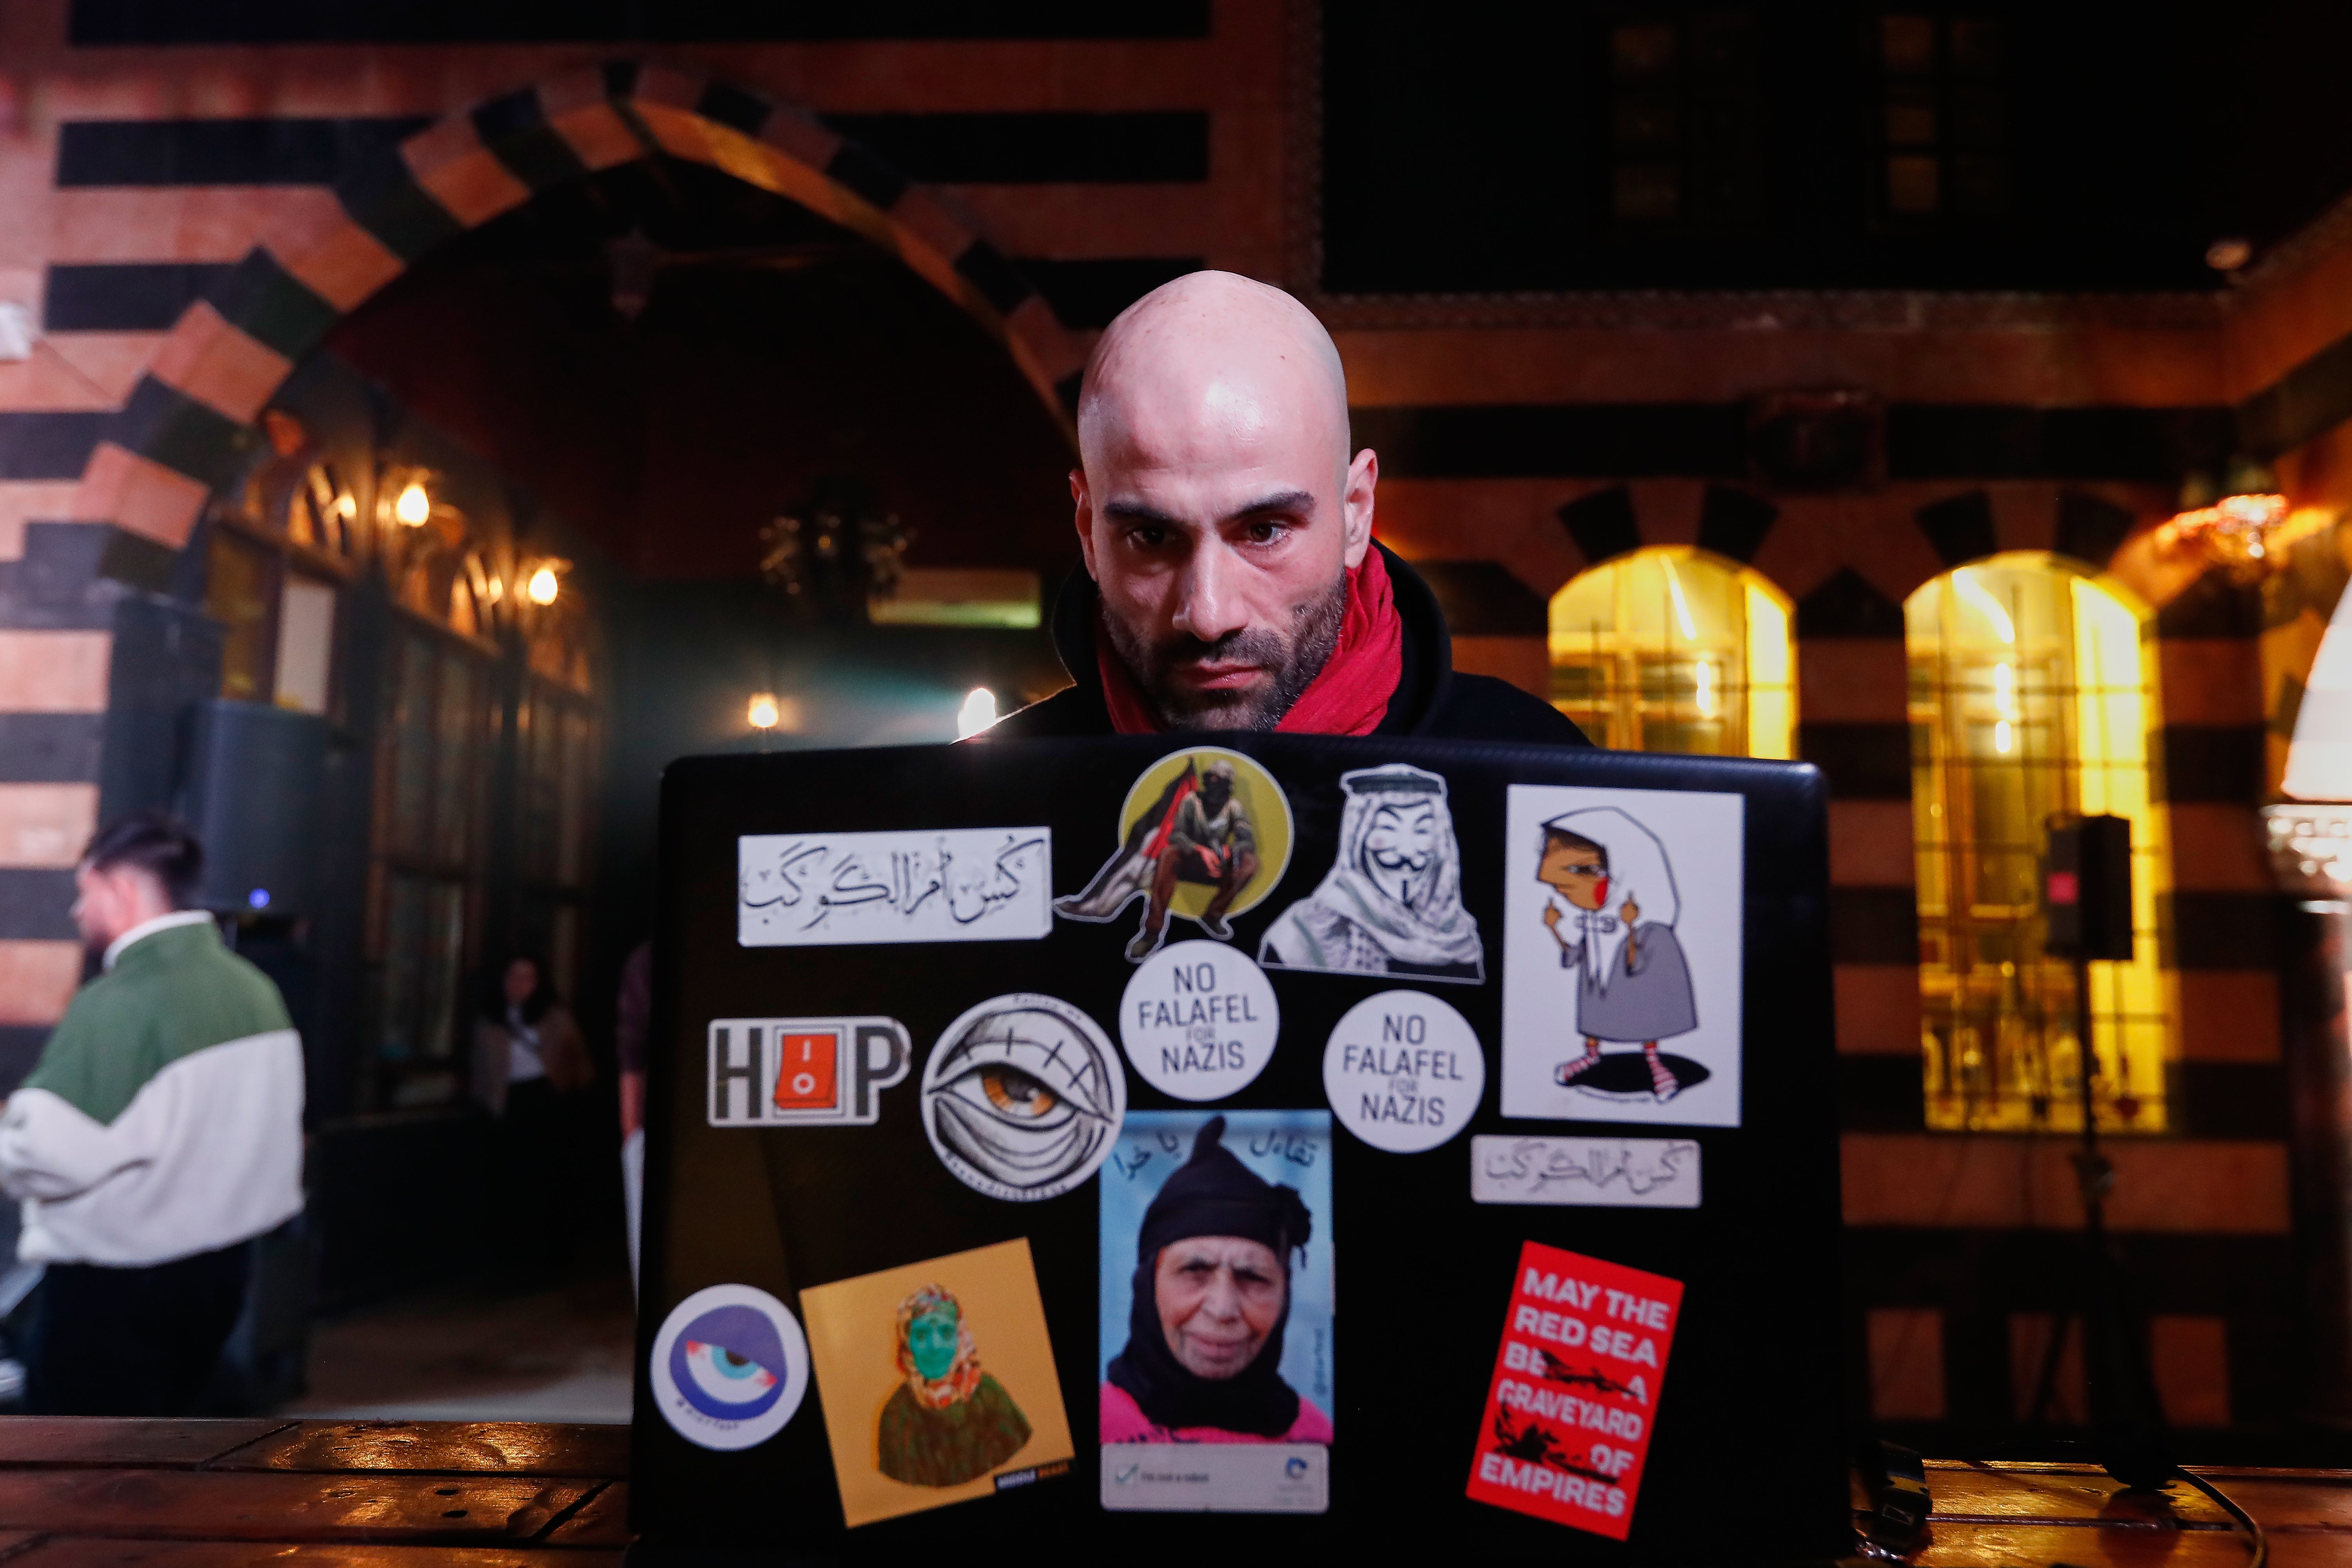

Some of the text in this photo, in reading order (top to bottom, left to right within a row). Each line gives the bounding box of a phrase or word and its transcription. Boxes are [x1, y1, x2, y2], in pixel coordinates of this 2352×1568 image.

[1173, 962, 1216, 993] NO
[1138, 993, 1259, 1029] FALAFEL
[1383, 1013, 1426, 1045] NO
[1161, 1040, 1245, 1074] NAZIS
[1343, 1044, 1464, 1081] FALAFEL
[1360, 1093, 1445, 1127] NAZIS
[1523, 1267, 1670, 1332] MAY THE
[1514, 1304, 1659, 1369] RED SEA
[1622, 1374, 1648, 1405] A
[1496, 1378, 1643, 1442] GRAVEYARD
[1590, 1443, 1635, 1476] OF
[1479, 1451, 1627, 1517] EMPIRES
